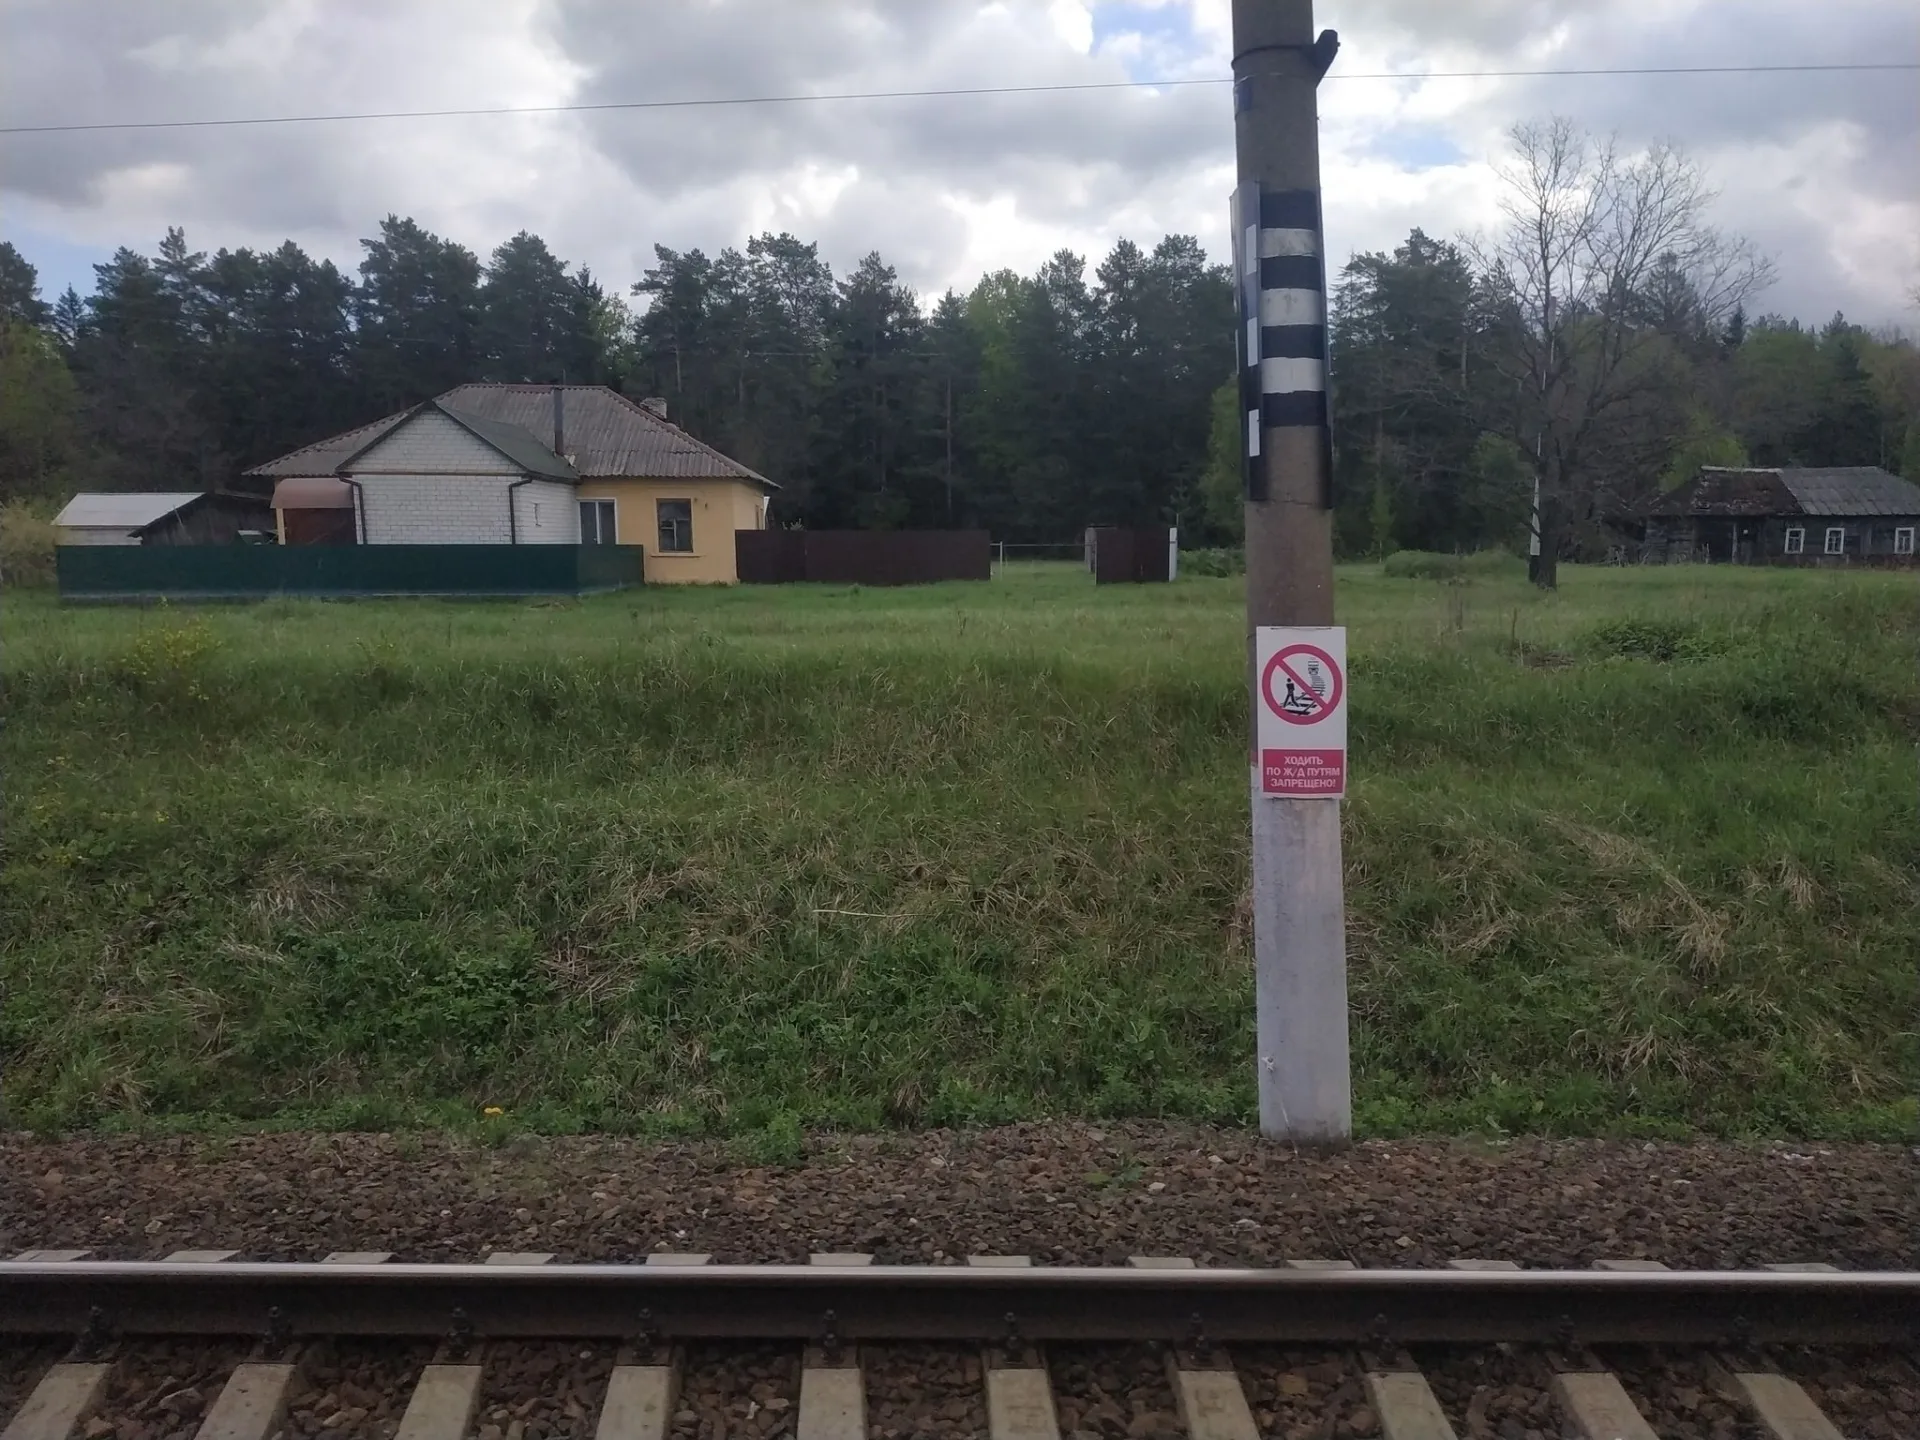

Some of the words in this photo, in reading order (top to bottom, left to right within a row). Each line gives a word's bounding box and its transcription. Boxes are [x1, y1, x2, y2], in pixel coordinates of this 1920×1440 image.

[1284, 756, 1323, 766] ХОДИТЬ
[1266, 767, 1281, 776] ПО
[1283, 767, 1305, 778] Ж/Д
[1307, 767, 1340, 776] ПУТЯМ
[1271, 778, 1336, 788] ЗАПРЕЩЕНО!
